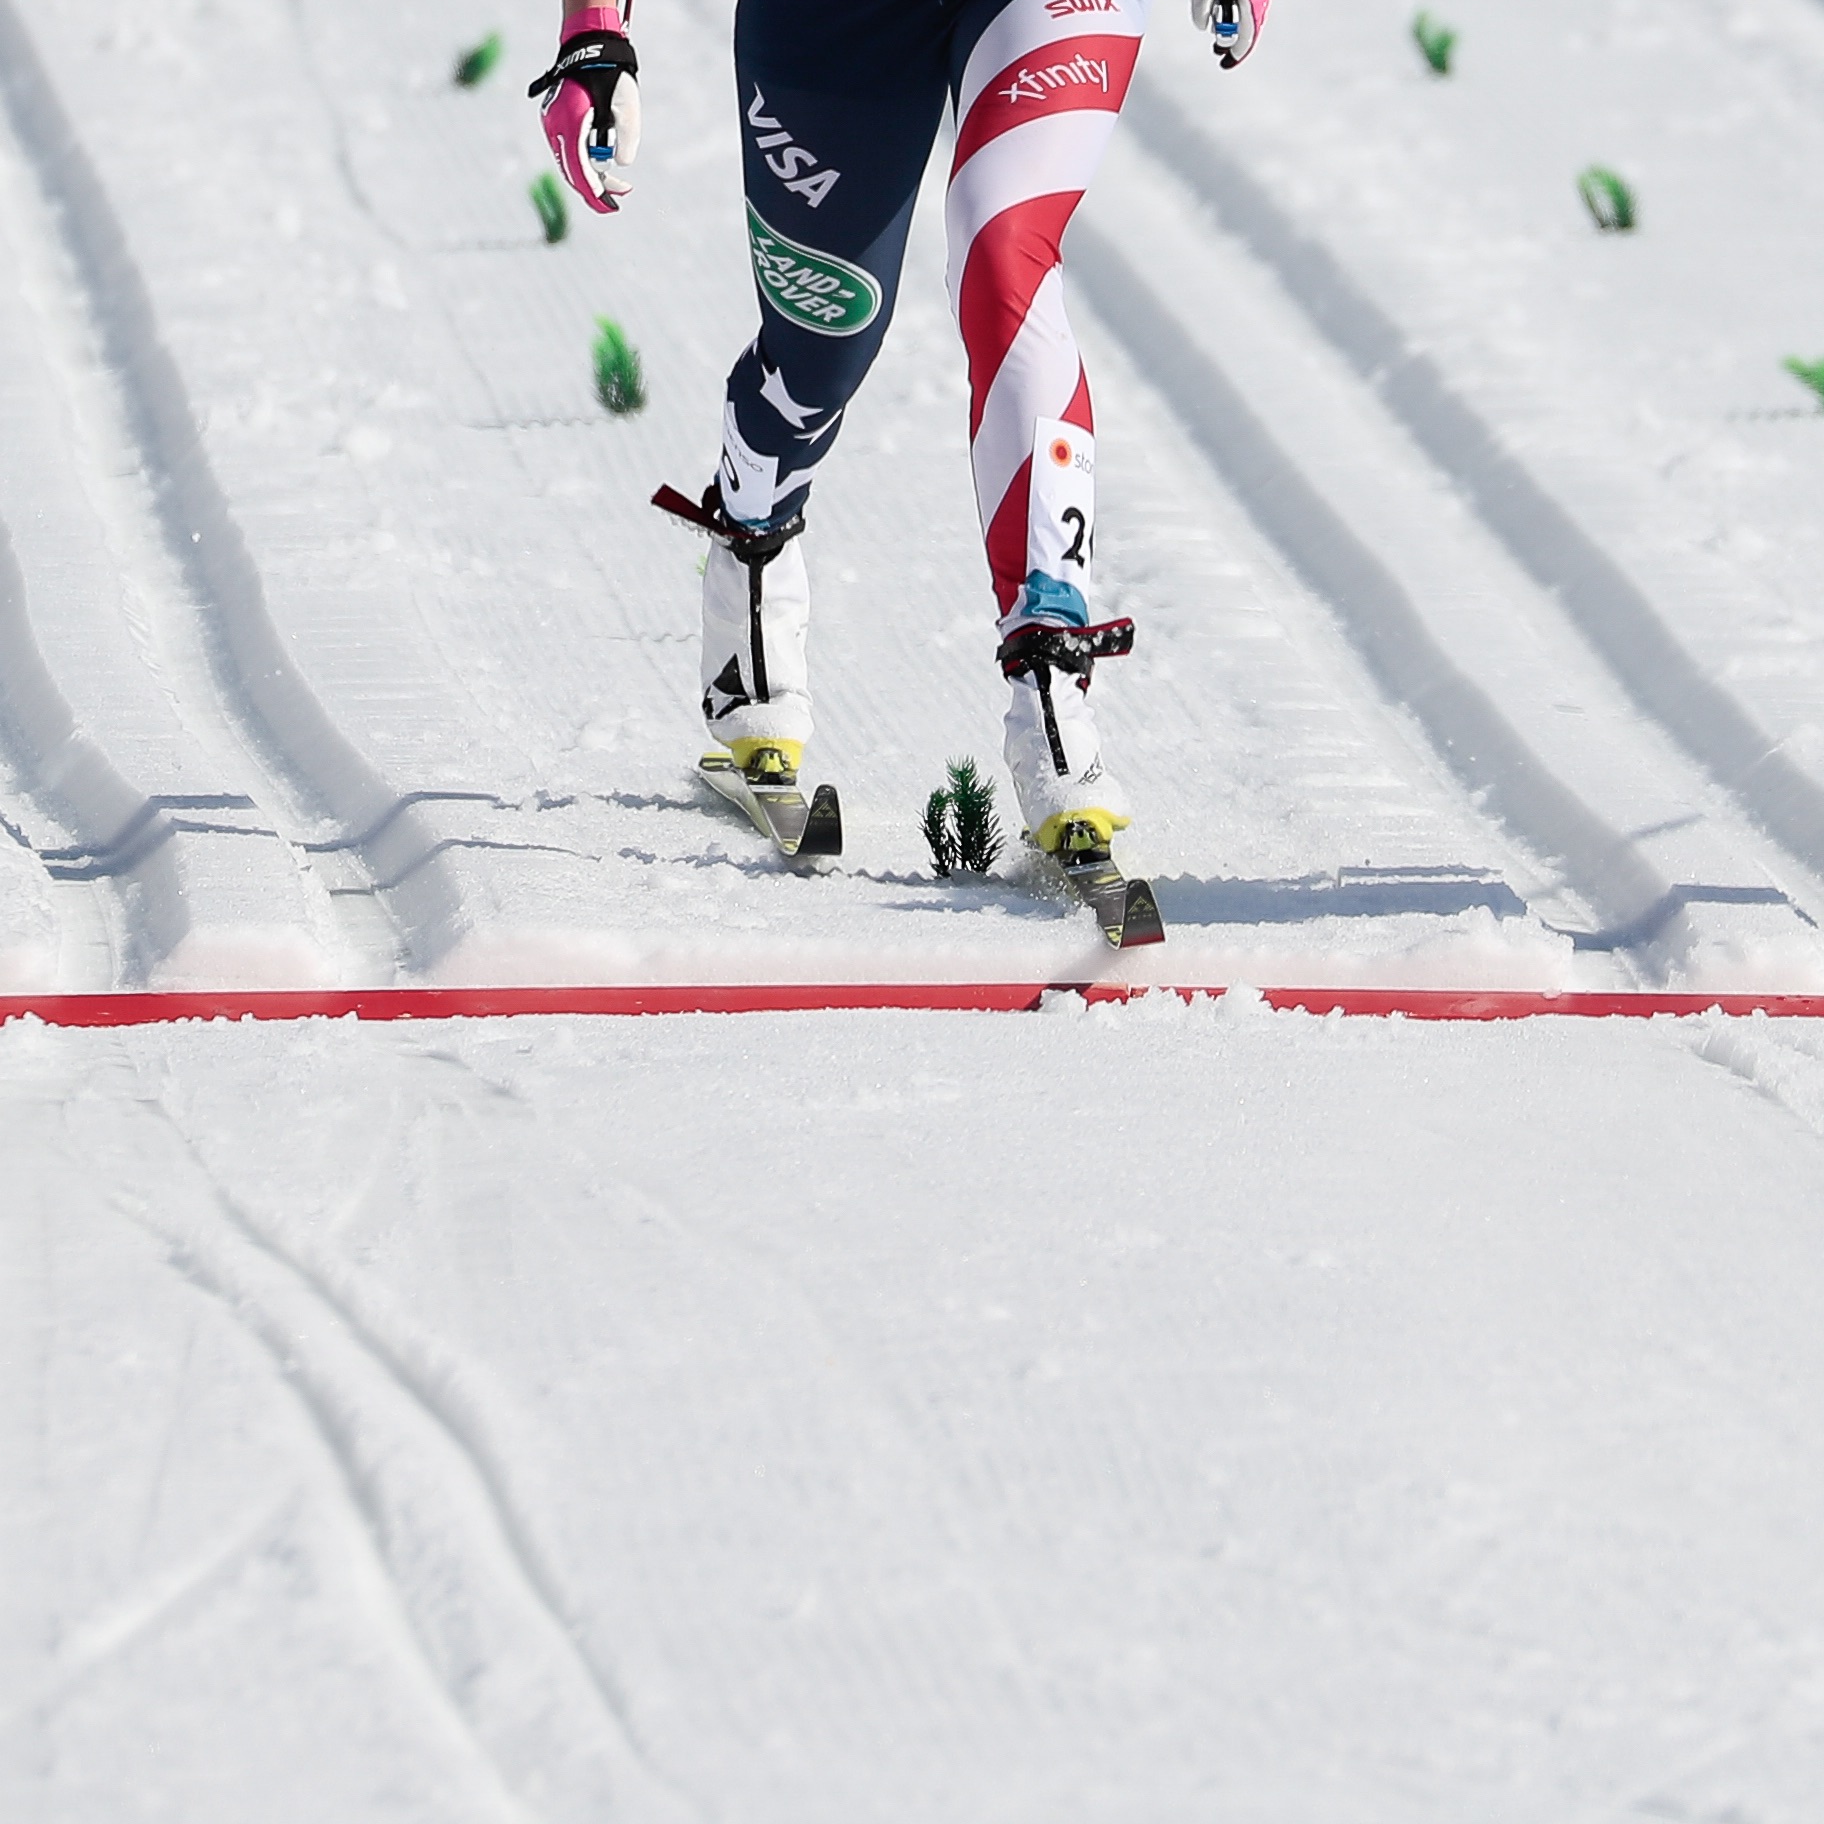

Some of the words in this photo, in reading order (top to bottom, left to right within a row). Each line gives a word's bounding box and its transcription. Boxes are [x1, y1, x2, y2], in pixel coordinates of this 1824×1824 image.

[998, 53, 1109, 104] xfinity
[747, 82, 841, 209] VISA
[753, 248, 847, 323] ROVER
